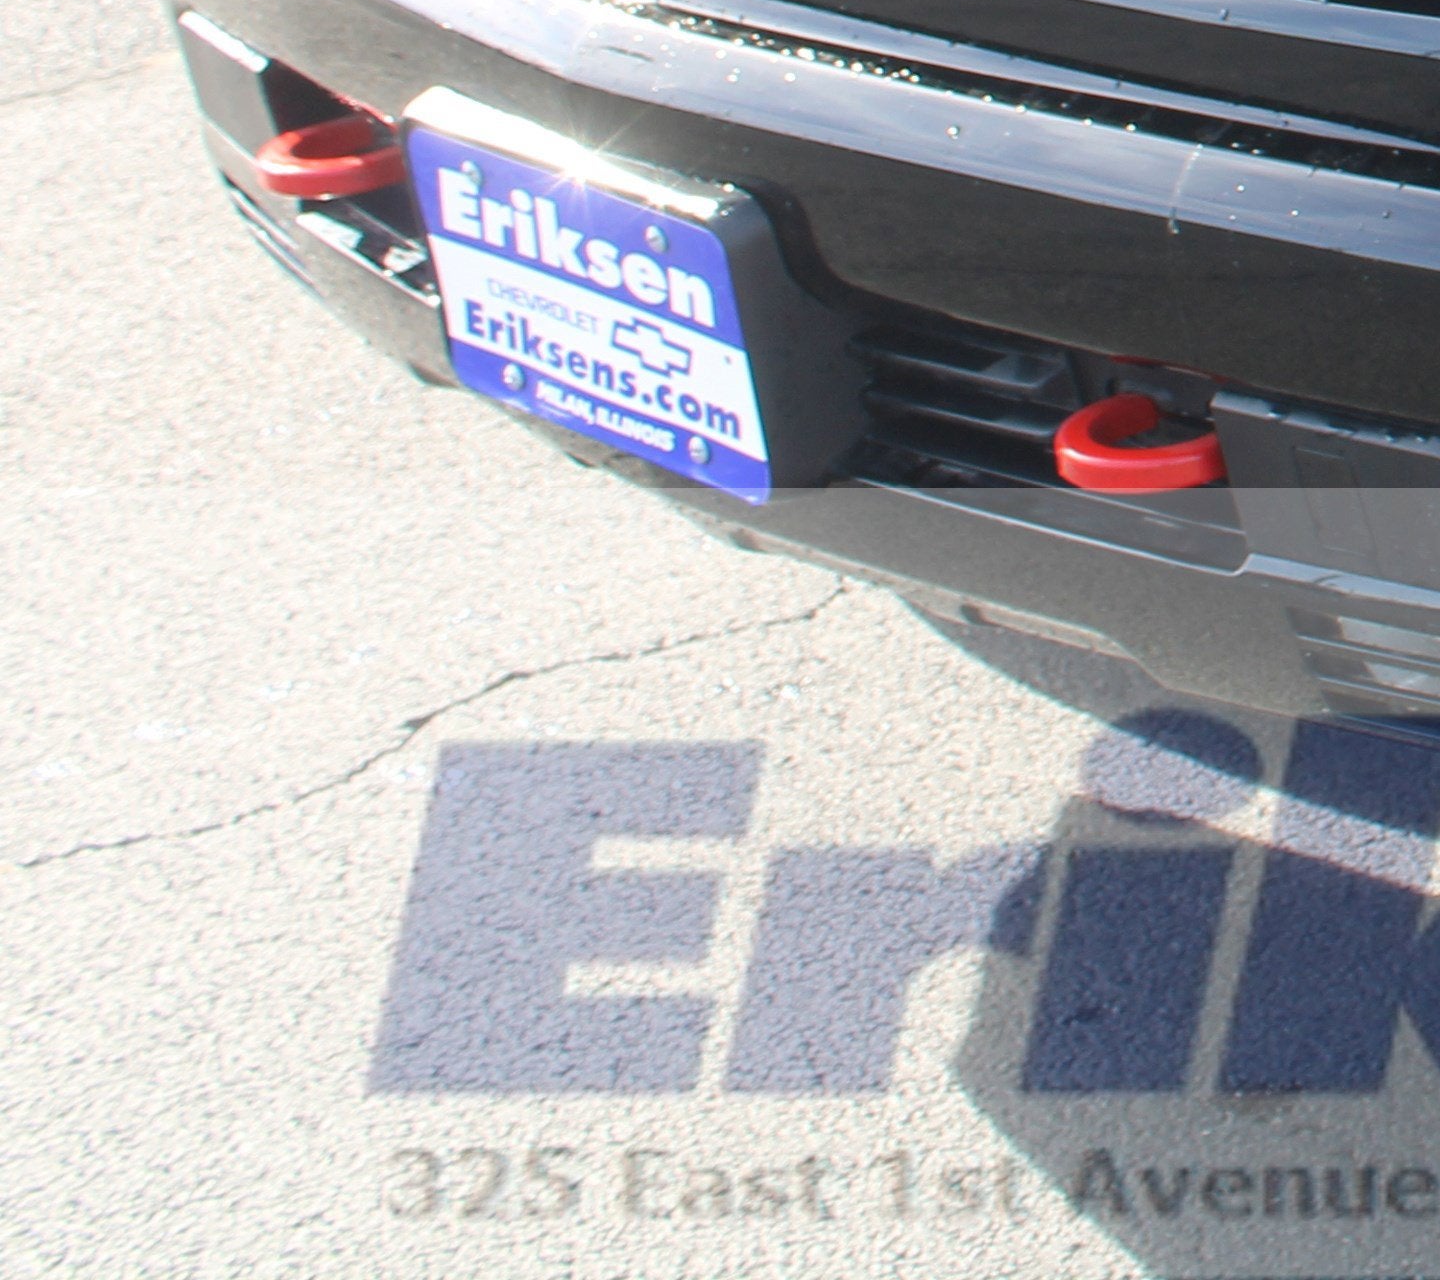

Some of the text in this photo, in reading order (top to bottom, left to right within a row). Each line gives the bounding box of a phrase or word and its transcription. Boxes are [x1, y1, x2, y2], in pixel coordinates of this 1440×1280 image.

[436, 166, 717, 329] Eriksen
[487, 277, 599, 335] CHEVROLET
[464, 298, 741, 441] Eriksens.com
